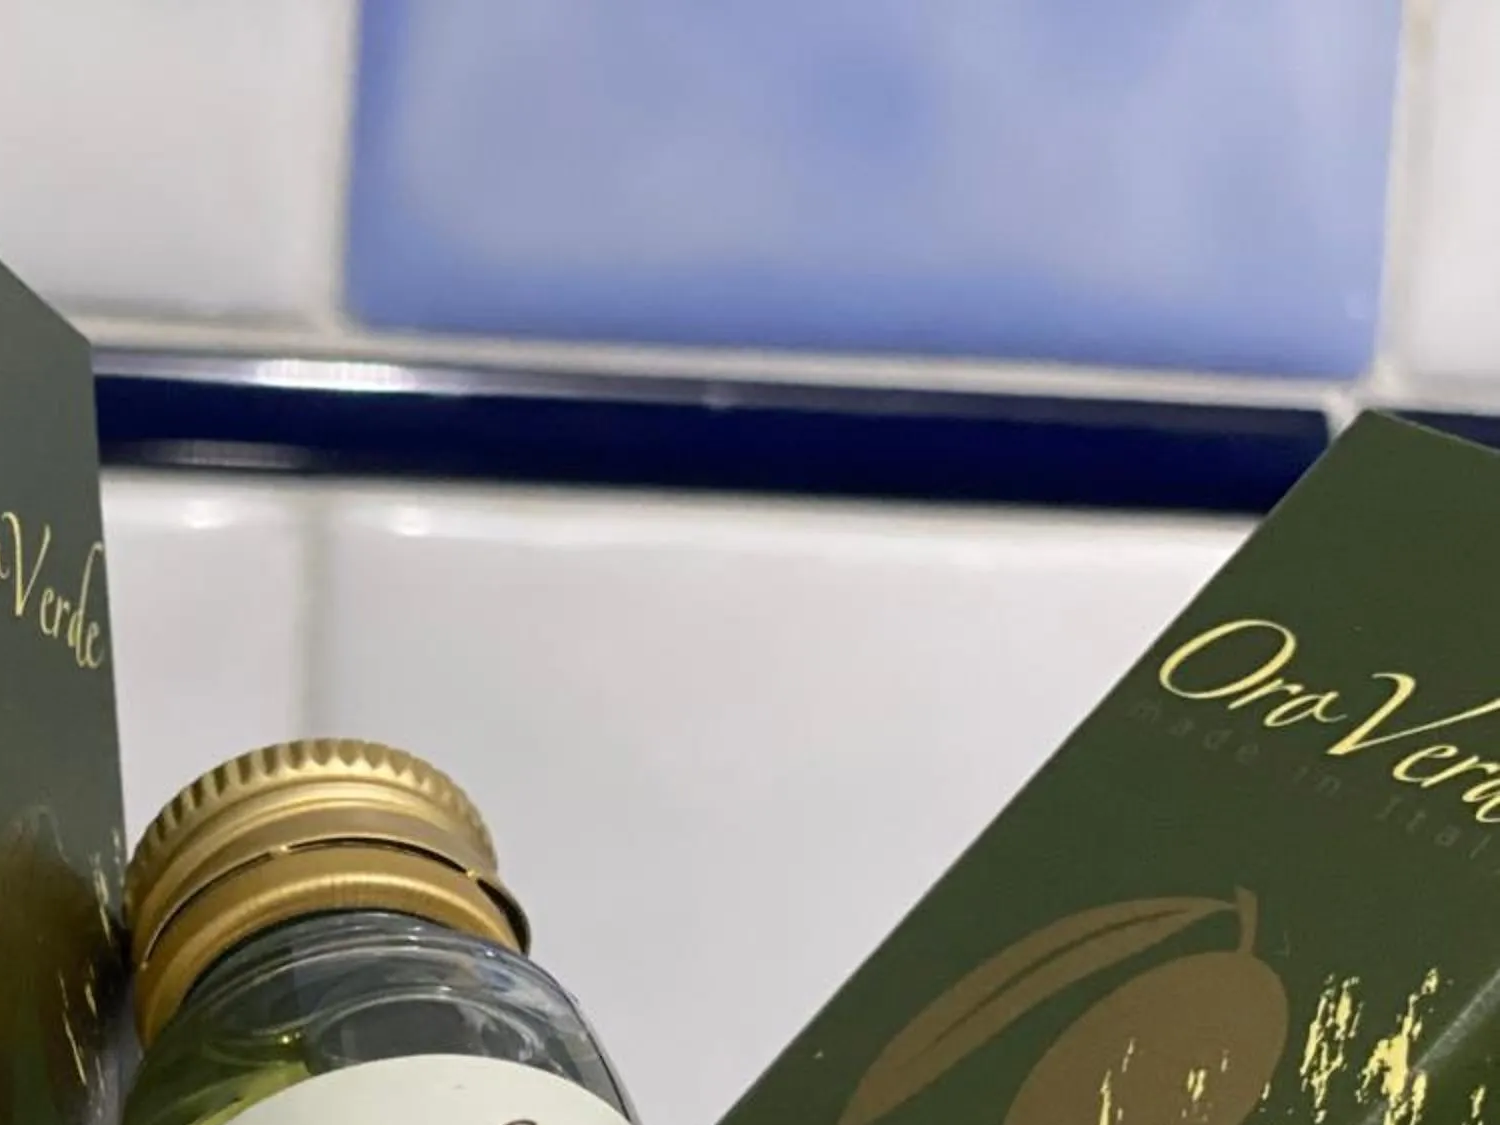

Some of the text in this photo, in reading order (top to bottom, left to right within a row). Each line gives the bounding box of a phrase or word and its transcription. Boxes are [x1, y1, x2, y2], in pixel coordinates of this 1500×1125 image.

[1, 510, 105, 670] Verde
[1130, 700, 1500, 877] made in Ital
[1325, 672, 1500, 824] Verd
